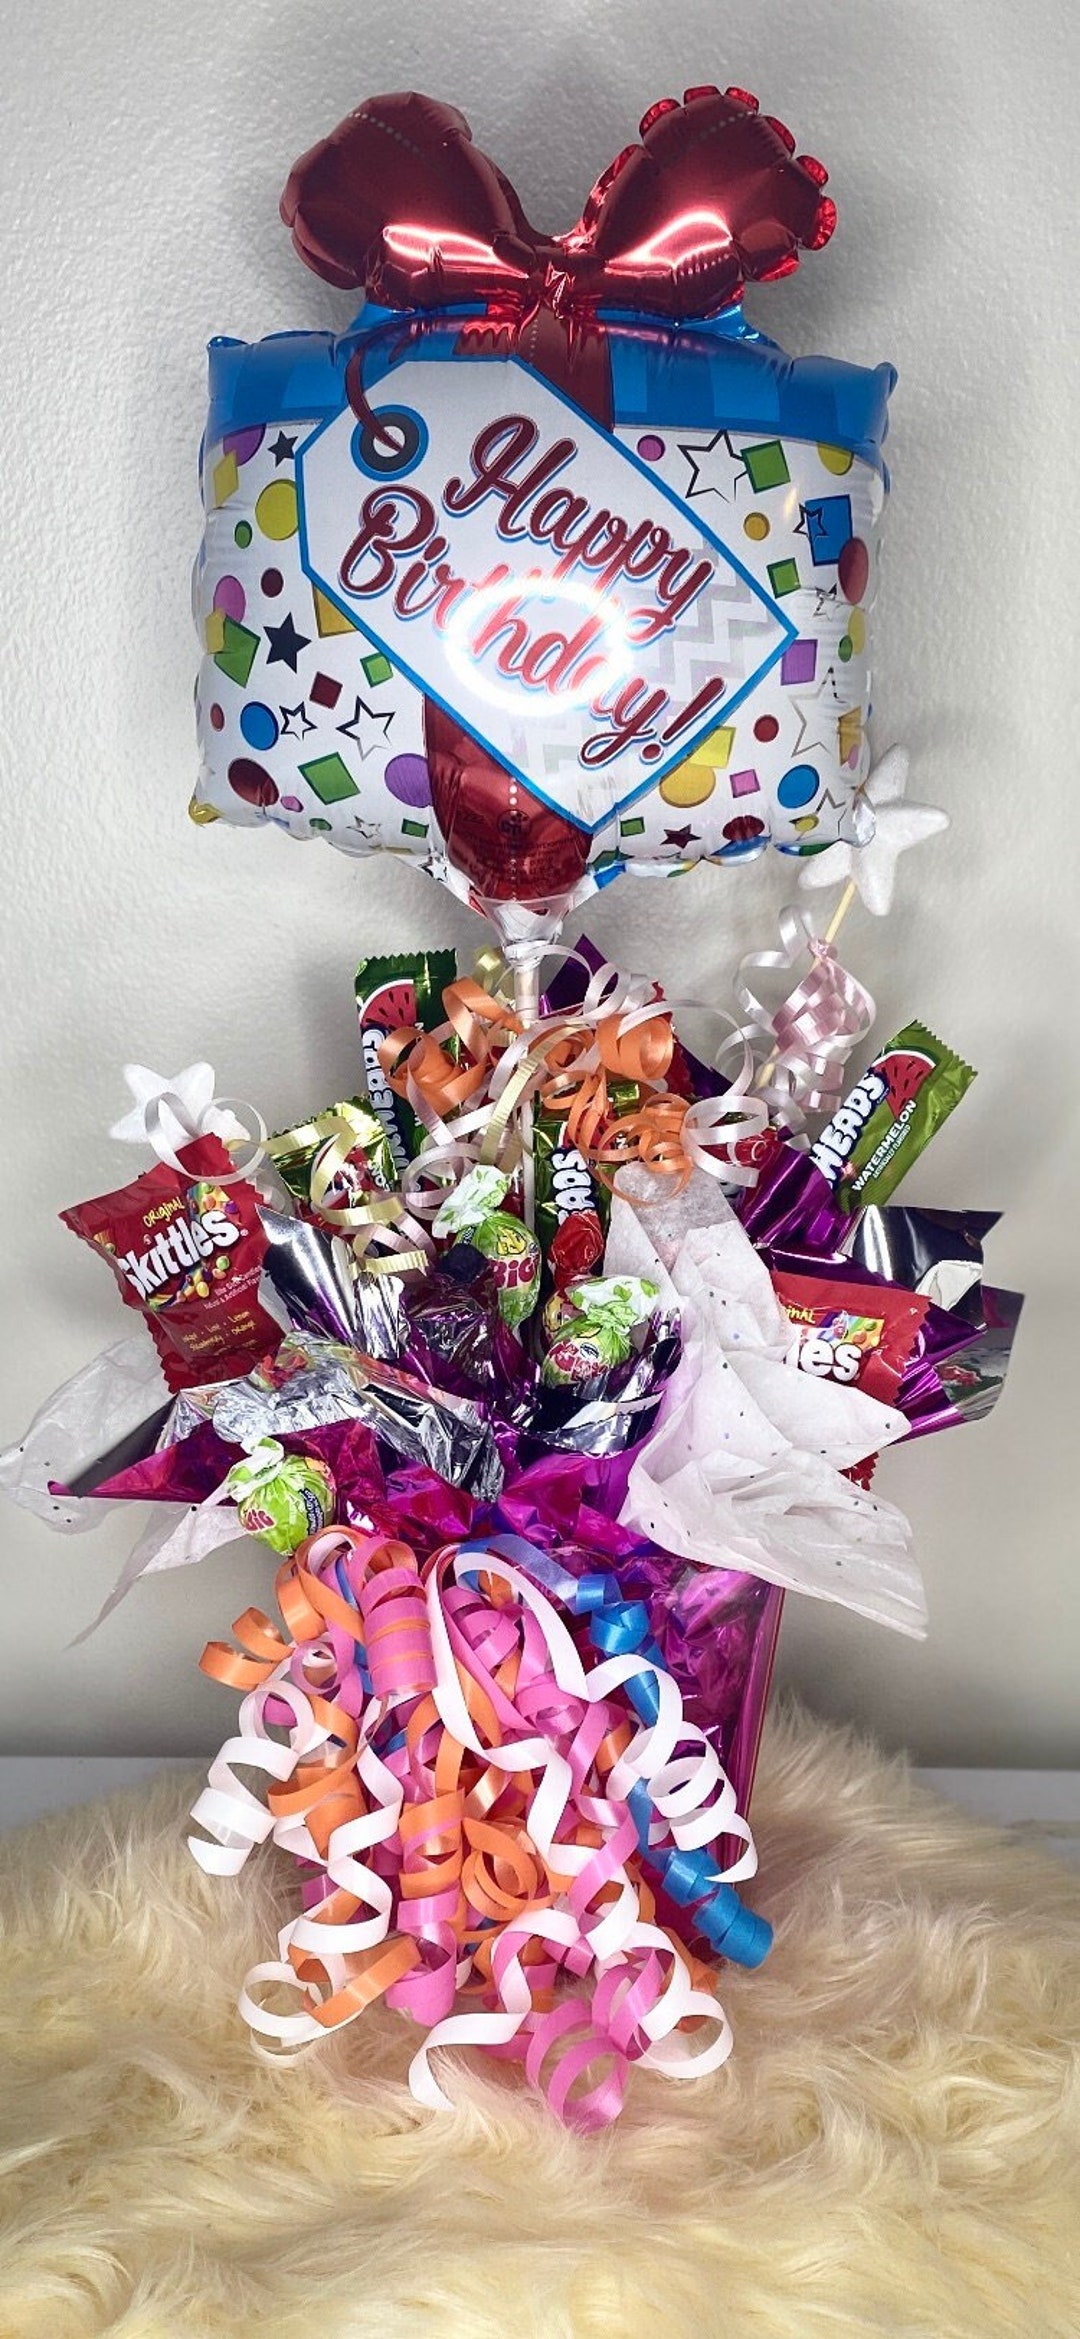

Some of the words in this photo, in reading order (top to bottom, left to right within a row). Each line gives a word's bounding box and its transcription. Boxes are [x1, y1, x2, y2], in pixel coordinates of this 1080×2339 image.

[442, 414, 715, 643] Happy
[808, 1072, 887, 1189] HEADS
[852, 1100, 917, 1191] WATERMELON
